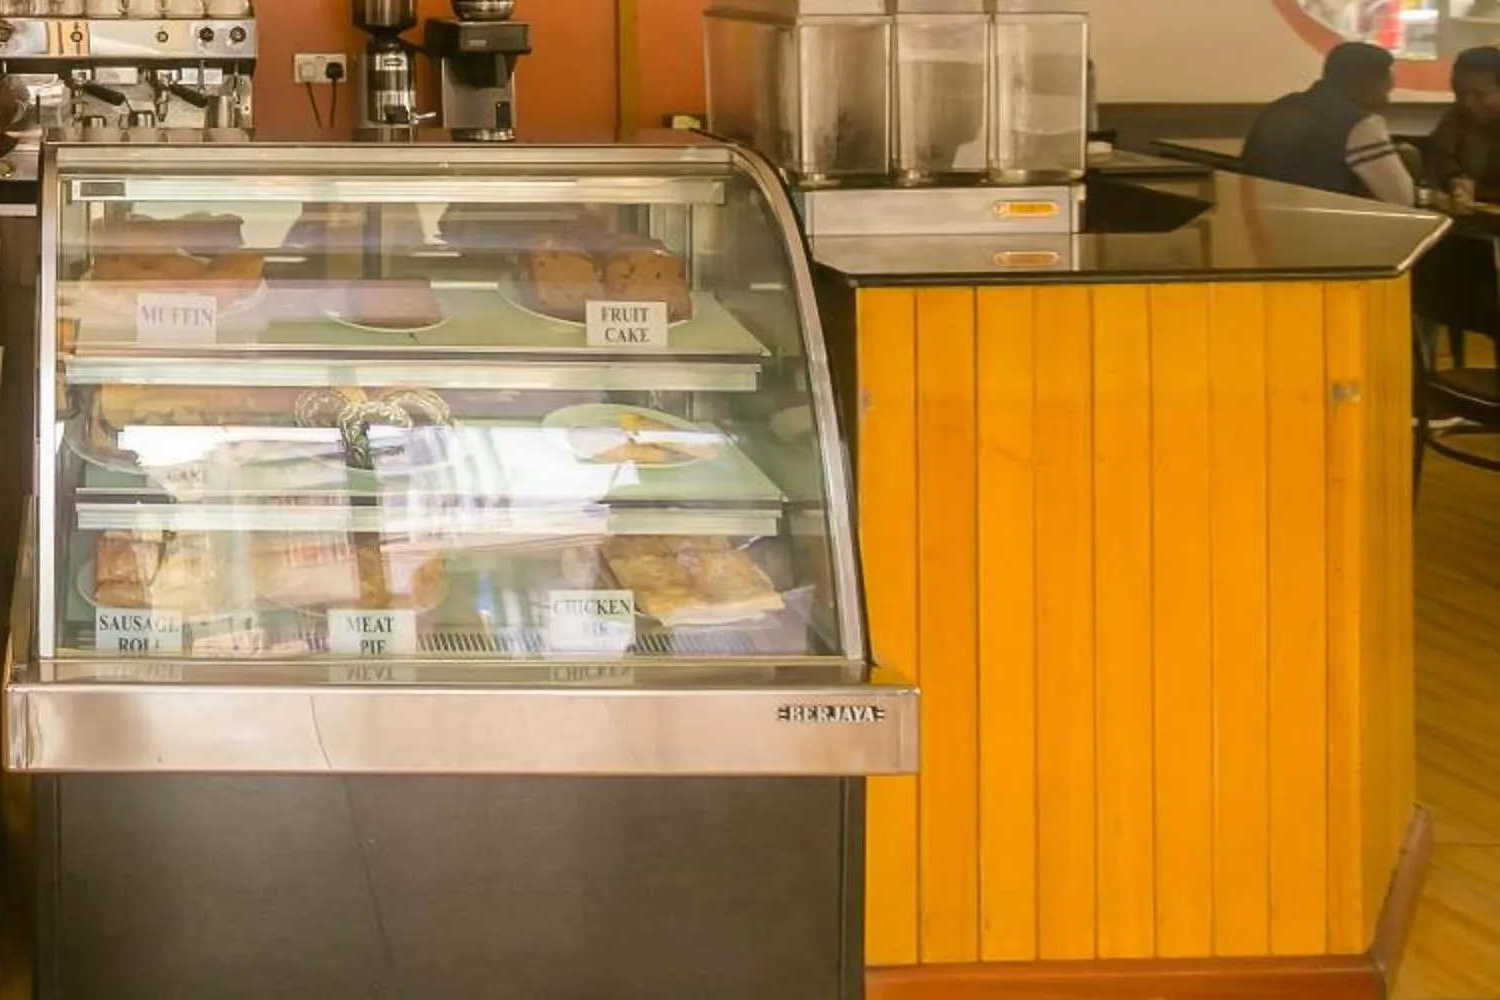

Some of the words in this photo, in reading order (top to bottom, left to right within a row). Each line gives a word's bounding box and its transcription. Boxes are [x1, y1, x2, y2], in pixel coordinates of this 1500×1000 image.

[141, 305, 214, 330] MUFFIN
[601, 306, 649, 323] FRUIT
[605, 327, 650, 344] CAKE
[553, 599, 630, 616] CHICKEN
[347, 615, 394, 633] MEAT
[787, 705, 876, 722] BERJAYA
